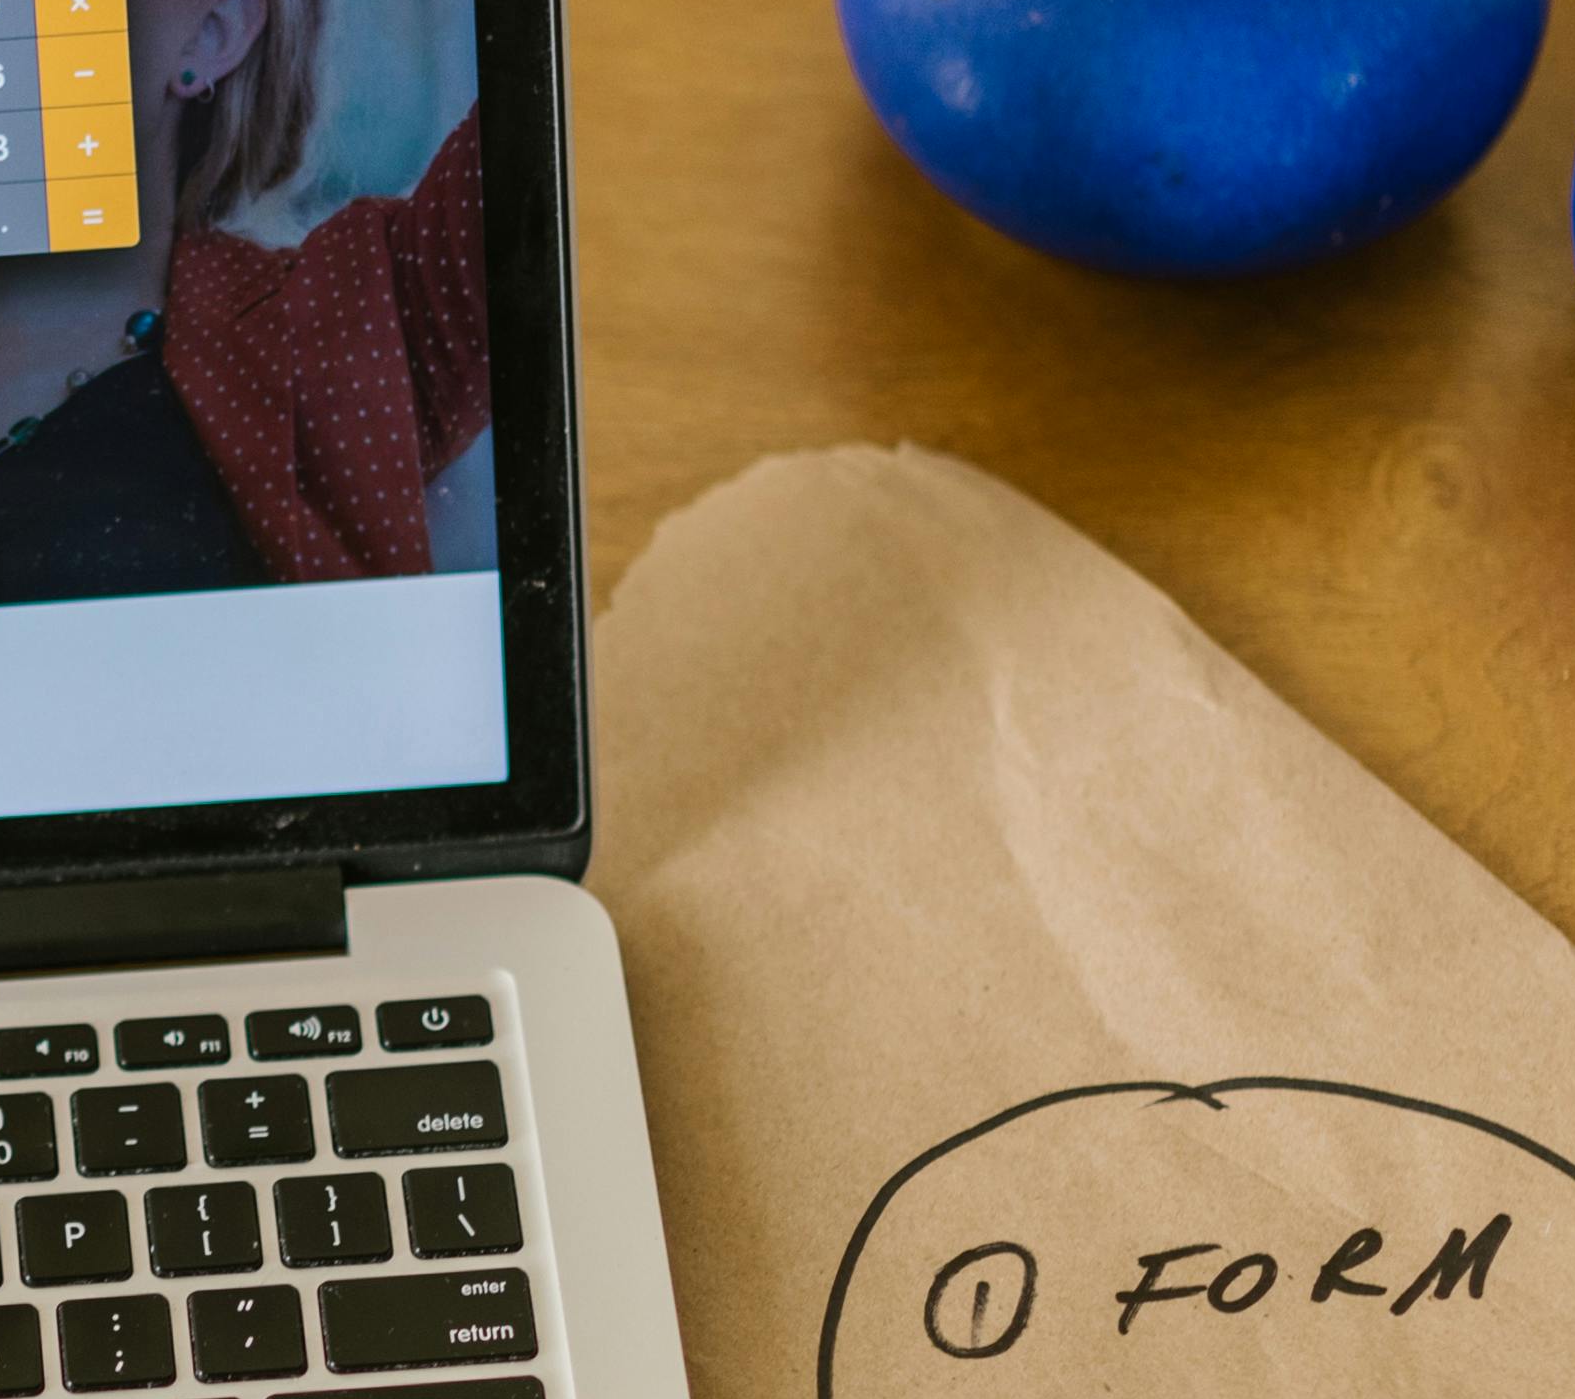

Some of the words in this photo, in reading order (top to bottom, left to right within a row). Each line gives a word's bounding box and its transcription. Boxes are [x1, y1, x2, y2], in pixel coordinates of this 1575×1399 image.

[327, 1029, 352, 1043] F12
[199, 1039, 221, 1053] F11
[64, 1049, 90, 1063] F10
[417, 1112, 484, 1133] delete
[64, 1221, 86, 1249] P
[1115, 1213, 1511, 1333] FORM
[461, 1280, 507, 1296] enter
[449, 1324, 515, 1344] return
